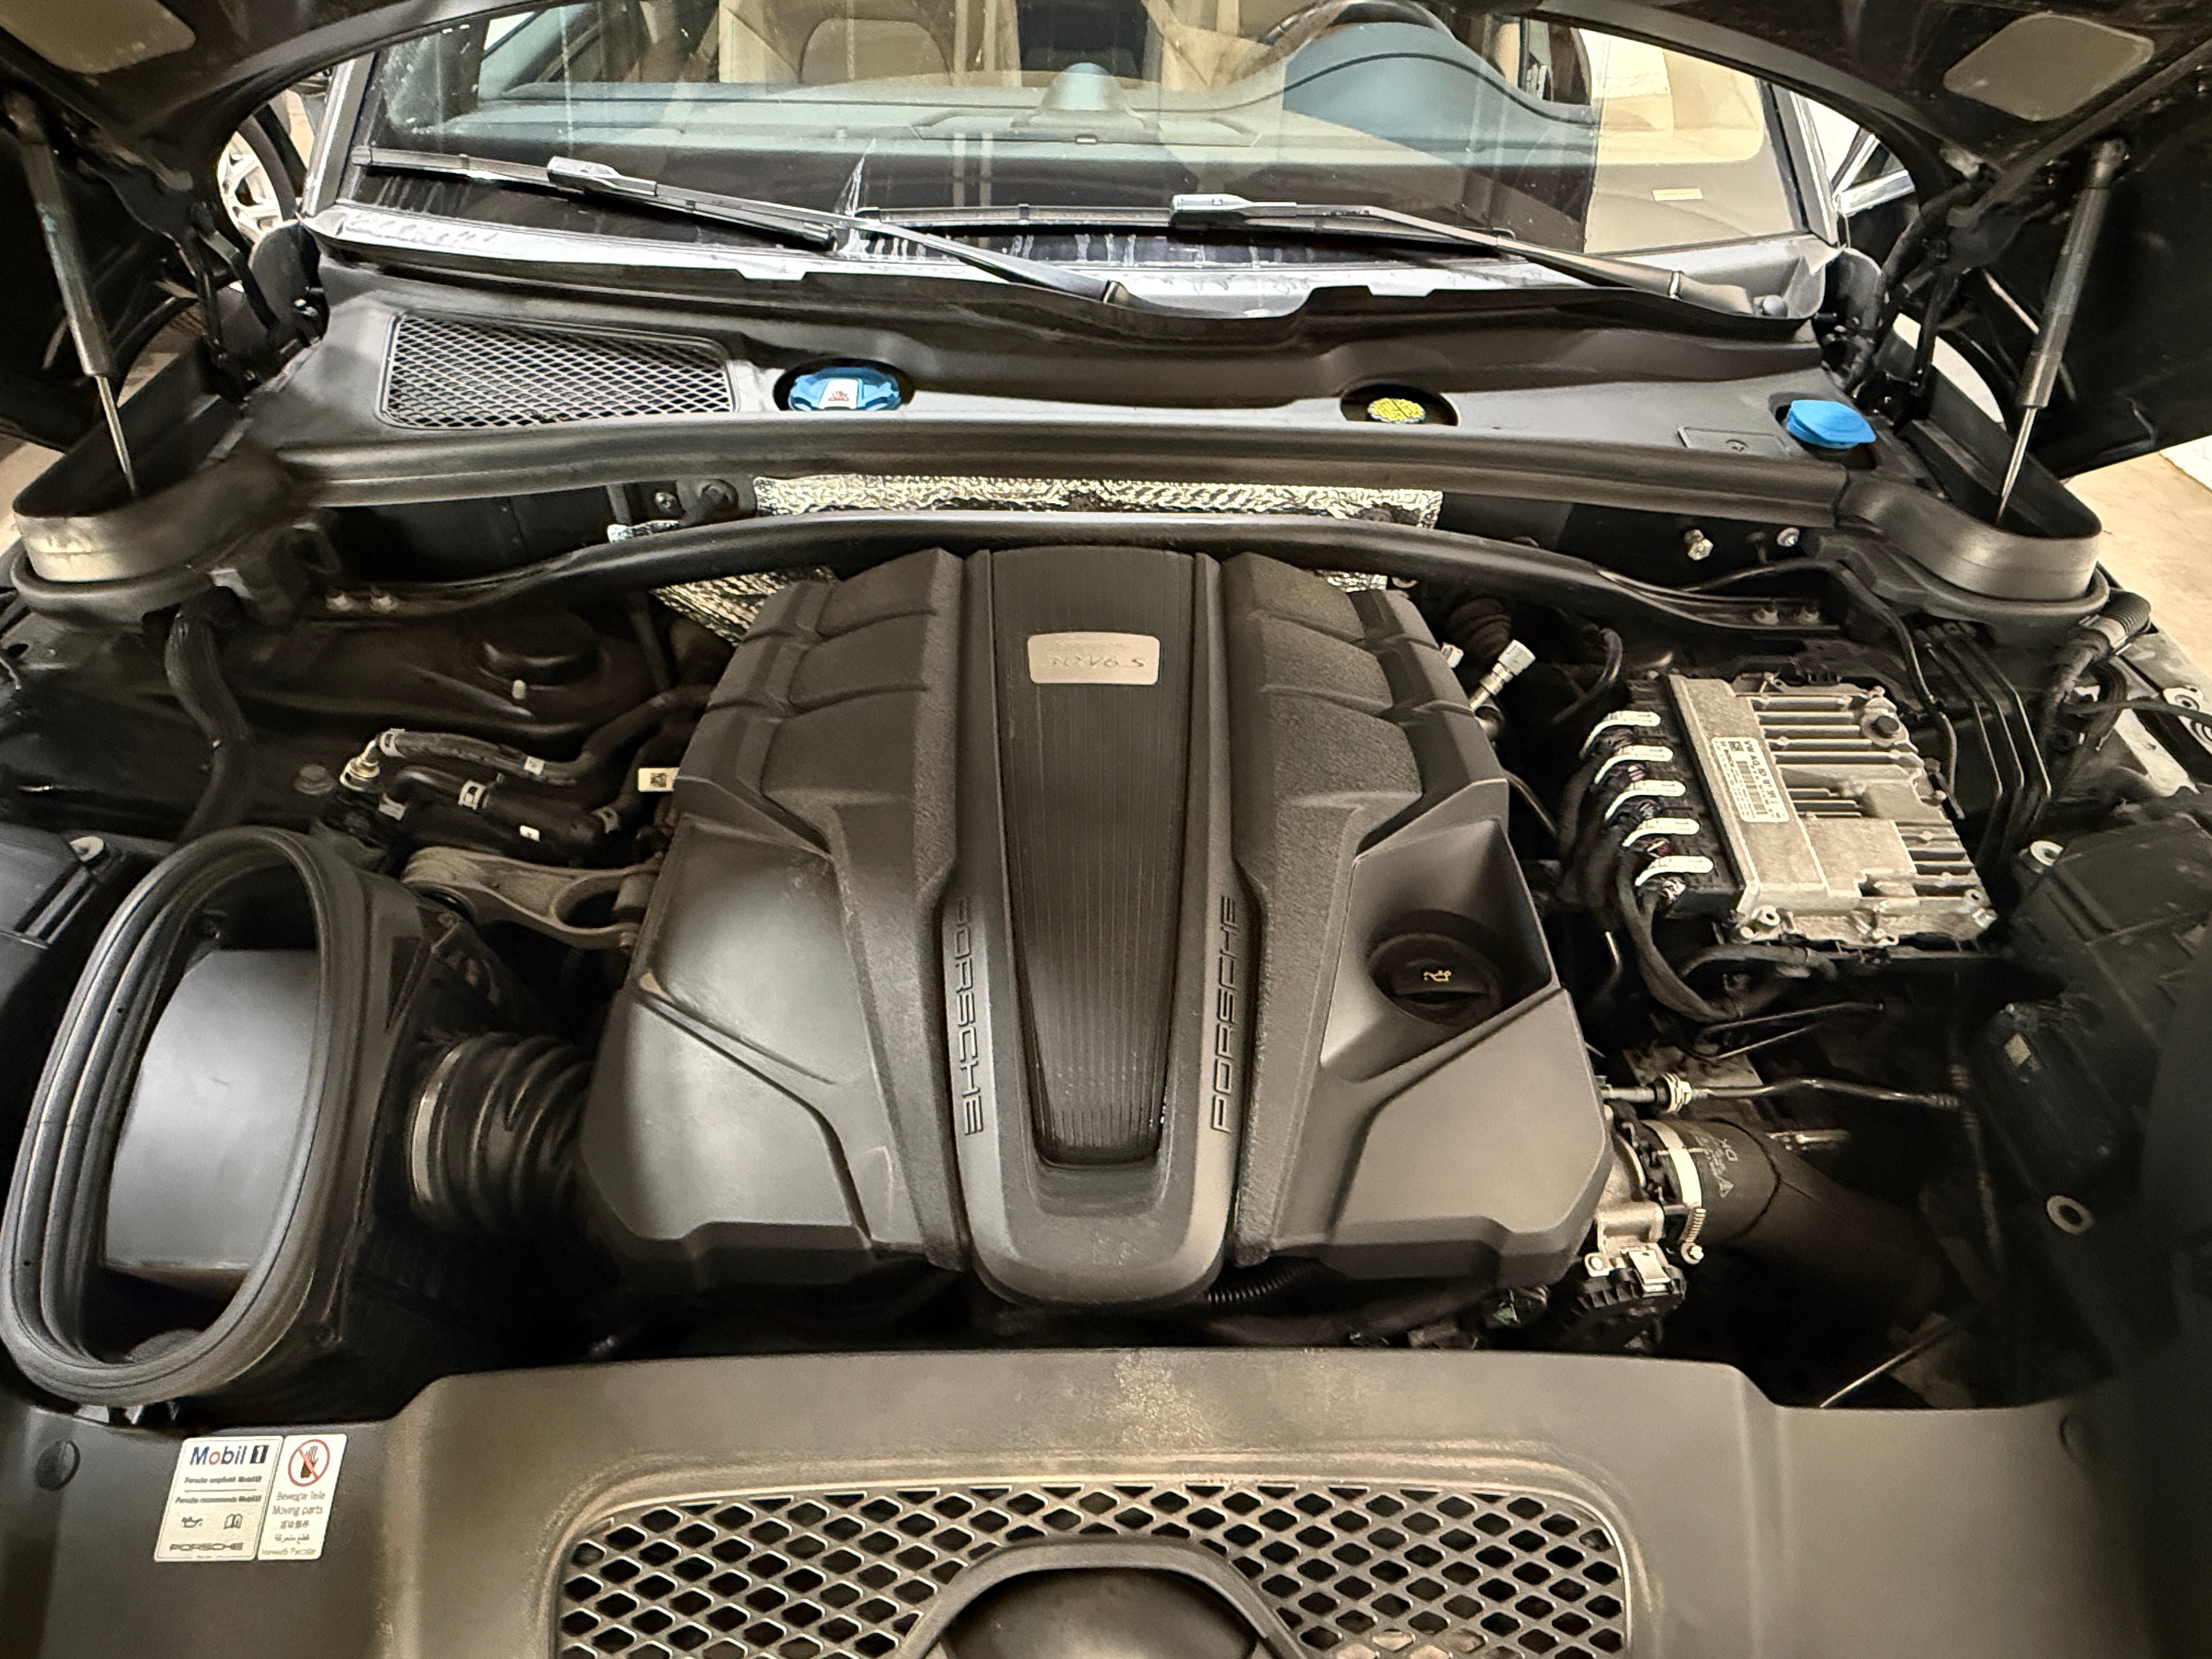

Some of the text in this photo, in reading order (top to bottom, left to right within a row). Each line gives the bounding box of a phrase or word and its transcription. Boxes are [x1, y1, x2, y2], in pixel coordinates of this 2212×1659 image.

[951, 896, 984, 1136] PORSCHE
[1209, 895, 1239, 1133] PORSCHE
[189, 1445, 269, 1465] Mobil 1
[271, 1505, 301, 1517] Moving
